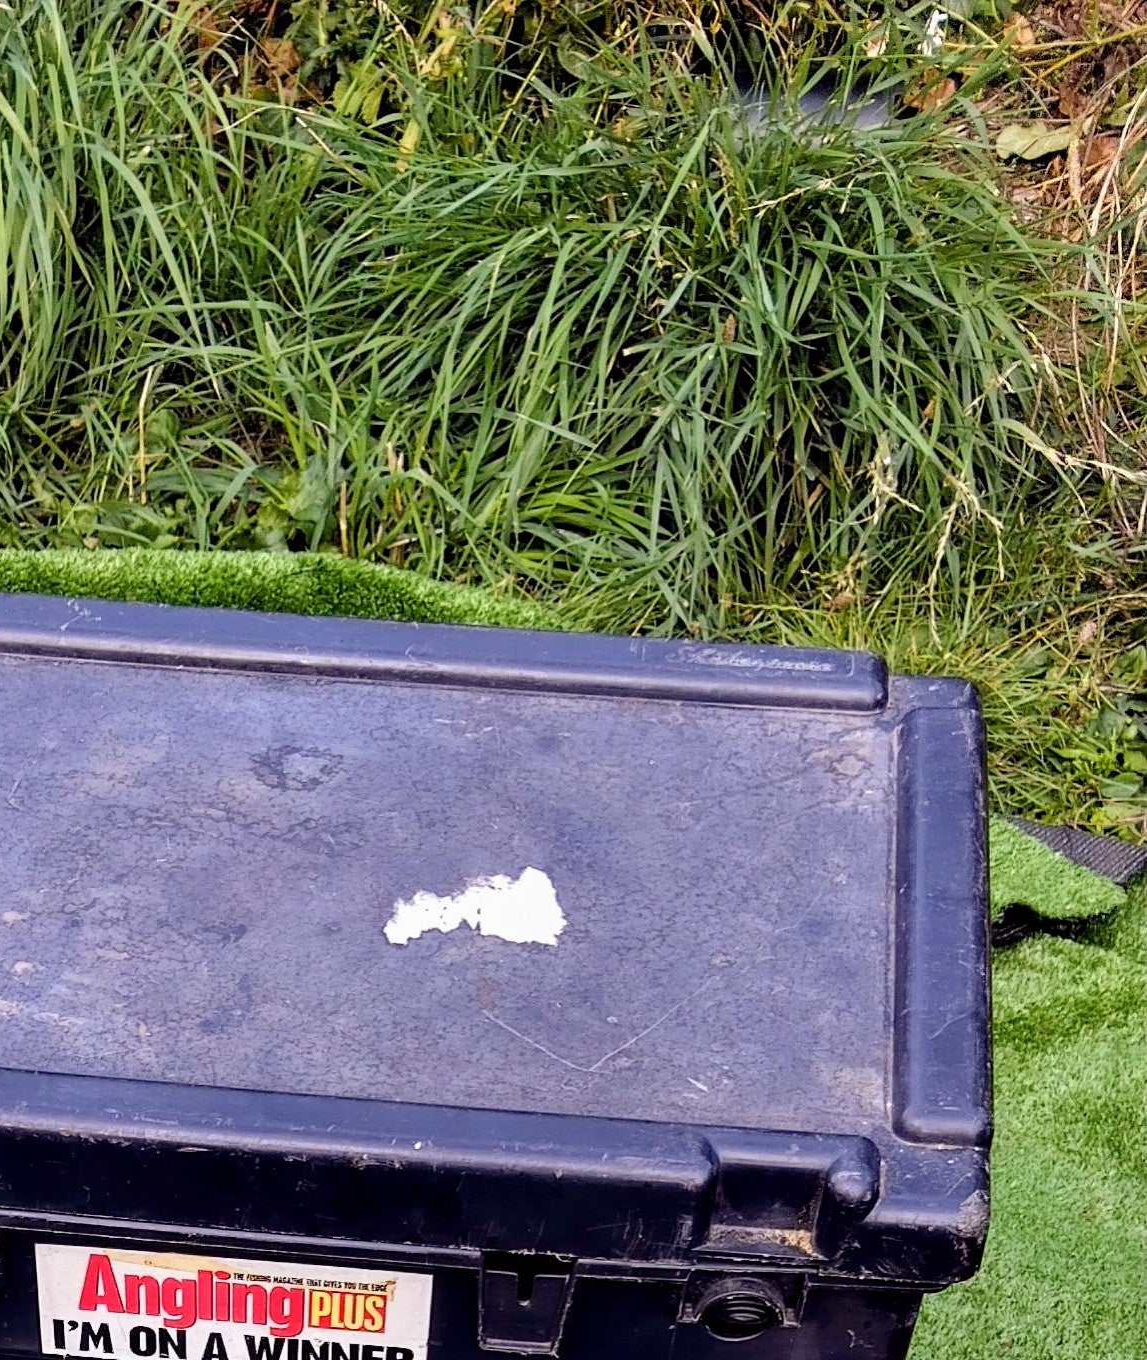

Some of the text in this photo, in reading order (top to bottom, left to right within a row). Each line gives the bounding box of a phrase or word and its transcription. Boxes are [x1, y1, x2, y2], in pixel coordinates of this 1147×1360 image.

[78, 1253, 386, 1338] Angling PLUS
[52, 1318, 114, 1355] I'M
[128, 1325, 187, 1360] ON
